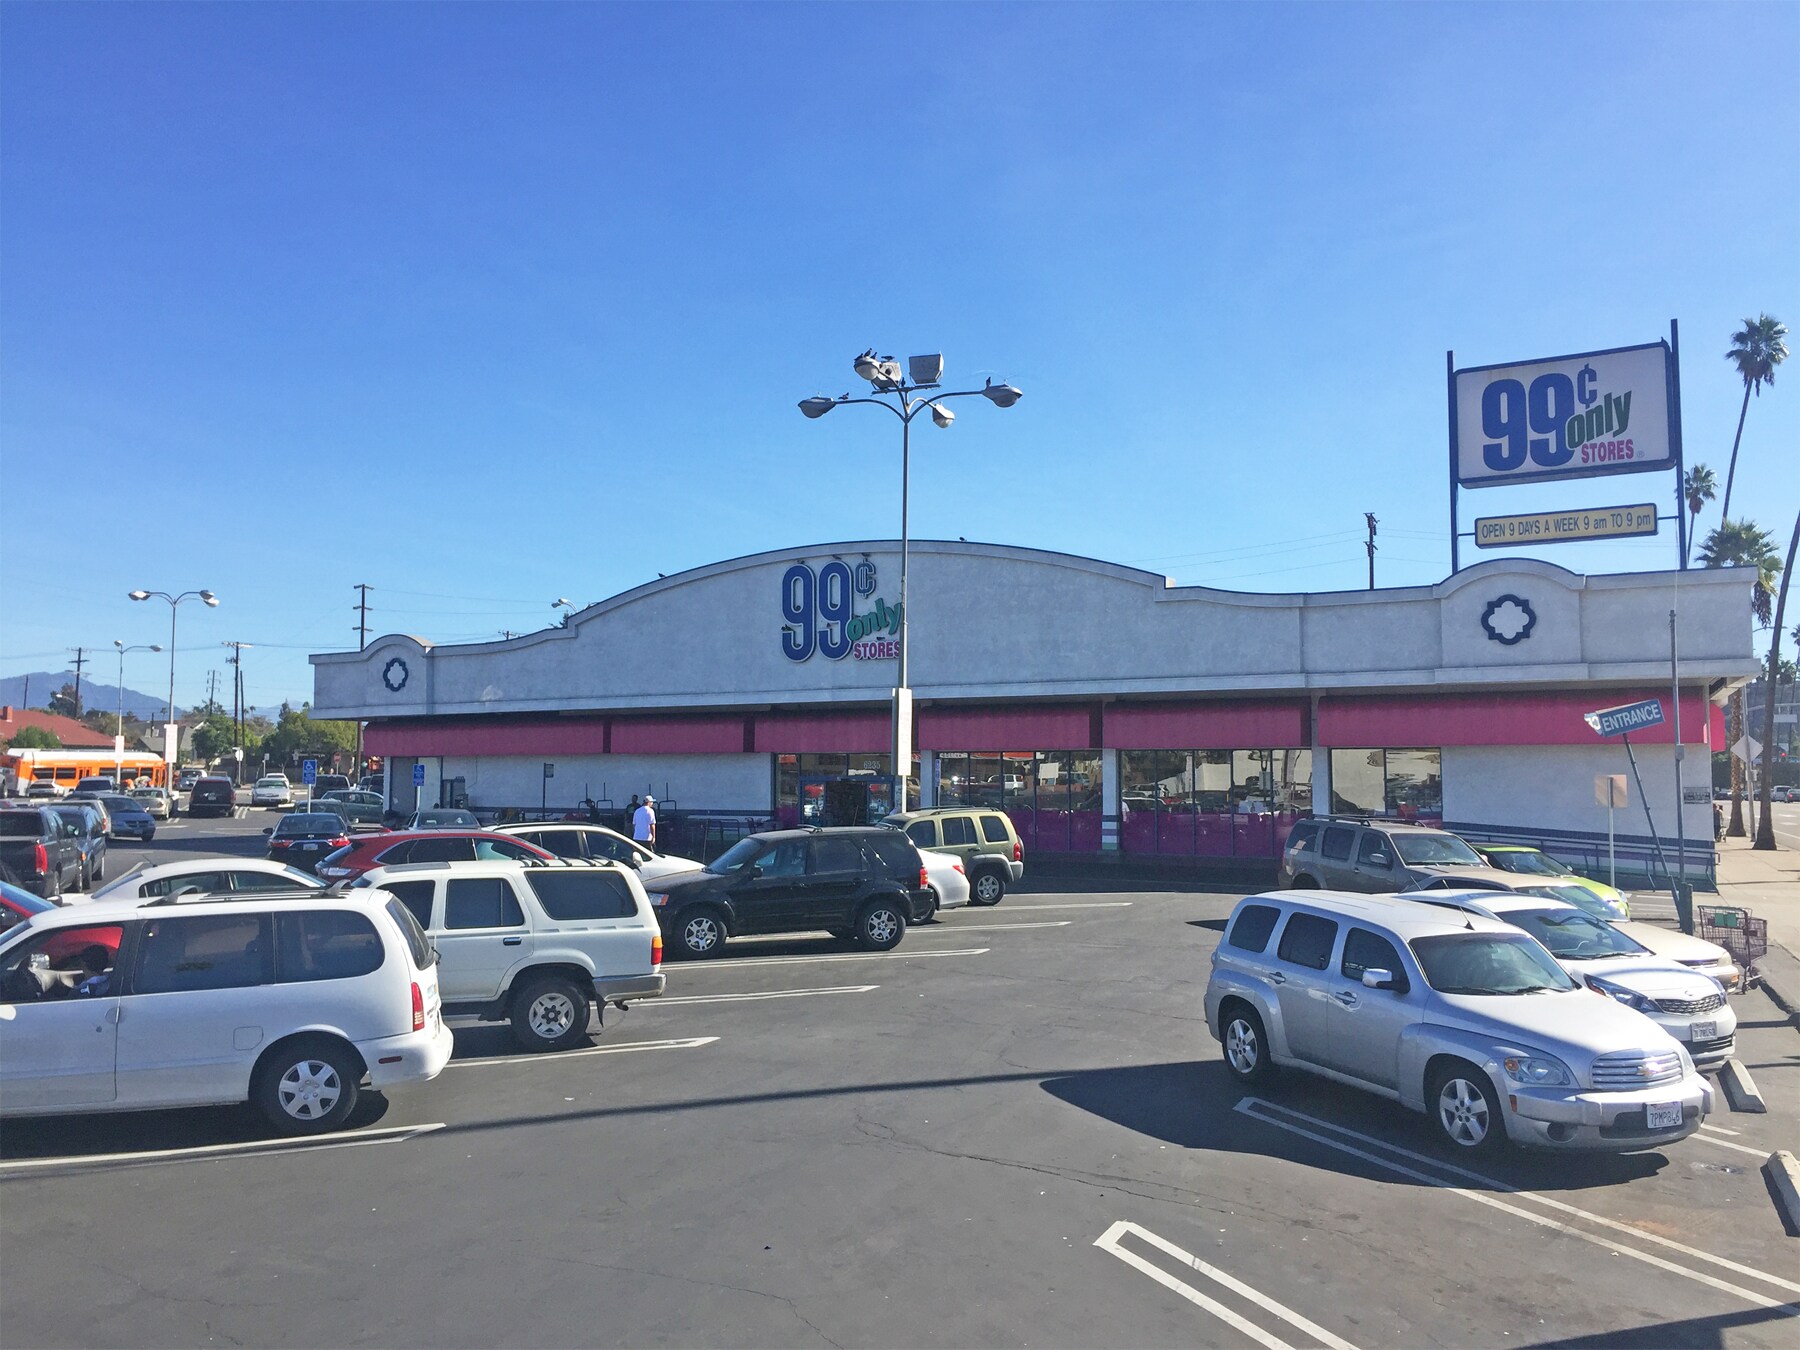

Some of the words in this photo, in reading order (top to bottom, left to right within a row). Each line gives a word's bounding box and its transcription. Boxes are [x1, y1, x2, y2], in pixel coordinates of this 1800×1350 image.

[1565, 390, 1632, 449] only
[1581, 439, 1634, 464] STORES
[1481, 523, 1506, 539] OPEN
[1508, 522, 1515, 536] 9
[1518, 519, 1541, 536] DAYS
[1543, 519, 1551, 533] A
[1553, 516, 1580, 532] WEEK
[1583, 515, 1590, 530] 9
[1593, 517, 1607, 529] am
[1610, 513, 1623, 528] TO
[1626, 512, 1633, 526] 9
[1636, 513, 1651, 529] pm
[846, 597, 902, 641] only
[853, 640, 901, 660] STORES
[1601, 703, 1661, 732] ENTRANCE
